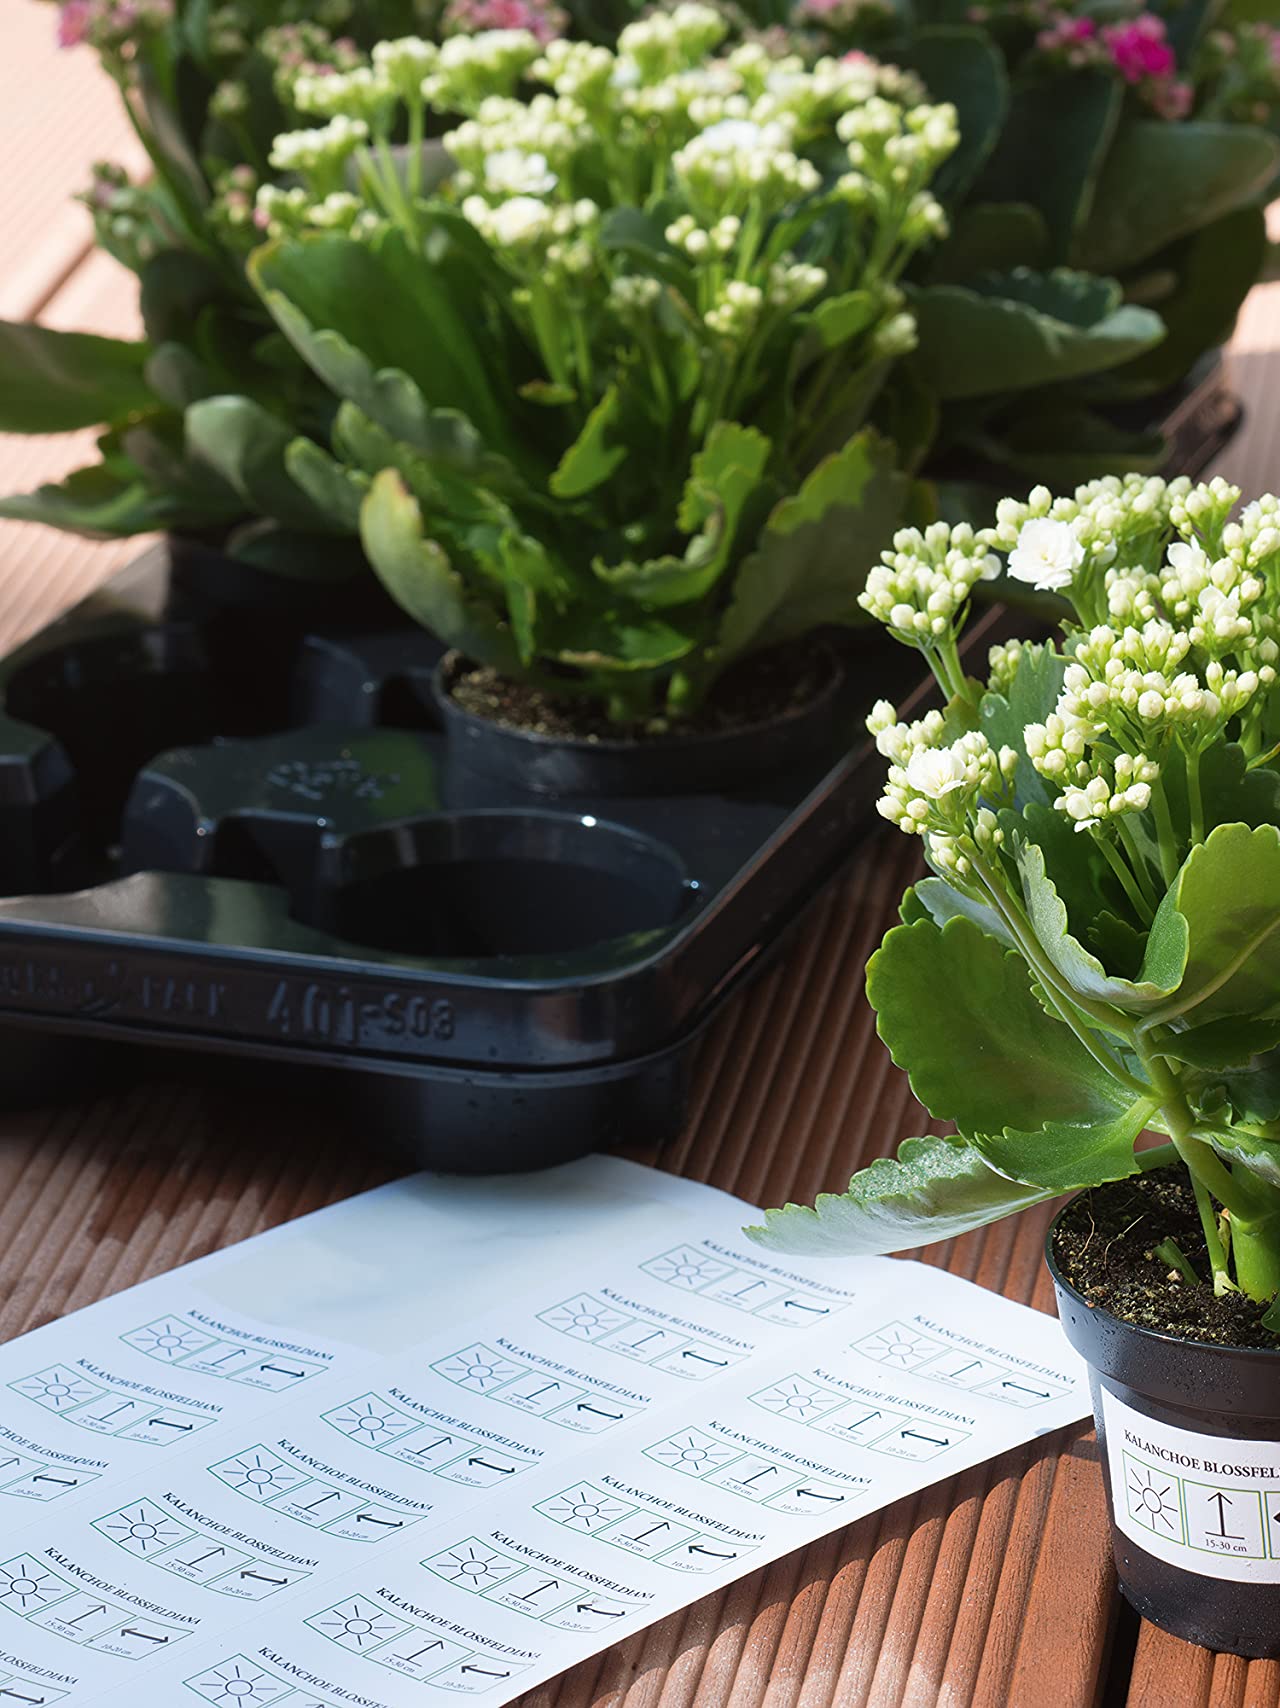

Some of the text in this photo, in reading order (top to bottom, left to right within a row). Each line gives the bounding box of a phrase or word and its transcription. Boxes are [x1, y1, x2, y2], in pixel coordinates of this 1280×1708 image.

[496, 1337, 652, 1403] KALANCHOE BLOSSFELDIANA
[913, 1315, 1077, 1385] KALANCHOE BLOSSFELDIANA
[388, 1387, 545, 1457] KALANCHOE BLOSSFELDIANA
[812, 1368, 977, 1426] KALANCHOE BLOSSFELDIANA
[0, 1424, 30, 1446] CHOE
[708, 1420, 874, 1484] KALANCHOE BLOSSFELDIANA
[1124, 1430, 1200, 1470] KALANCHOE
[277, 1438, 434, 1511] KALANCHOE BLOSSFELDIANA
[601, 1474, 767, 1541] KALANCHOE BLOSSFELDIANA
[162, 1491, 320, 1568] KALANCHOE BLOSSFELDIANA
[1205, 1538, 1230, 1551] 15-30
[44, 1546, 201, 1625] KALANCHOE BLOSSFELDIANA
[490, 1530, 655, 1599] KALANCHOE BLOSSFELDIANA
[376, 1587, 542, 1660] KALANCHOE BLOSSFELDIANA
[258, 1646, 334, 1691] KALANCHOE
